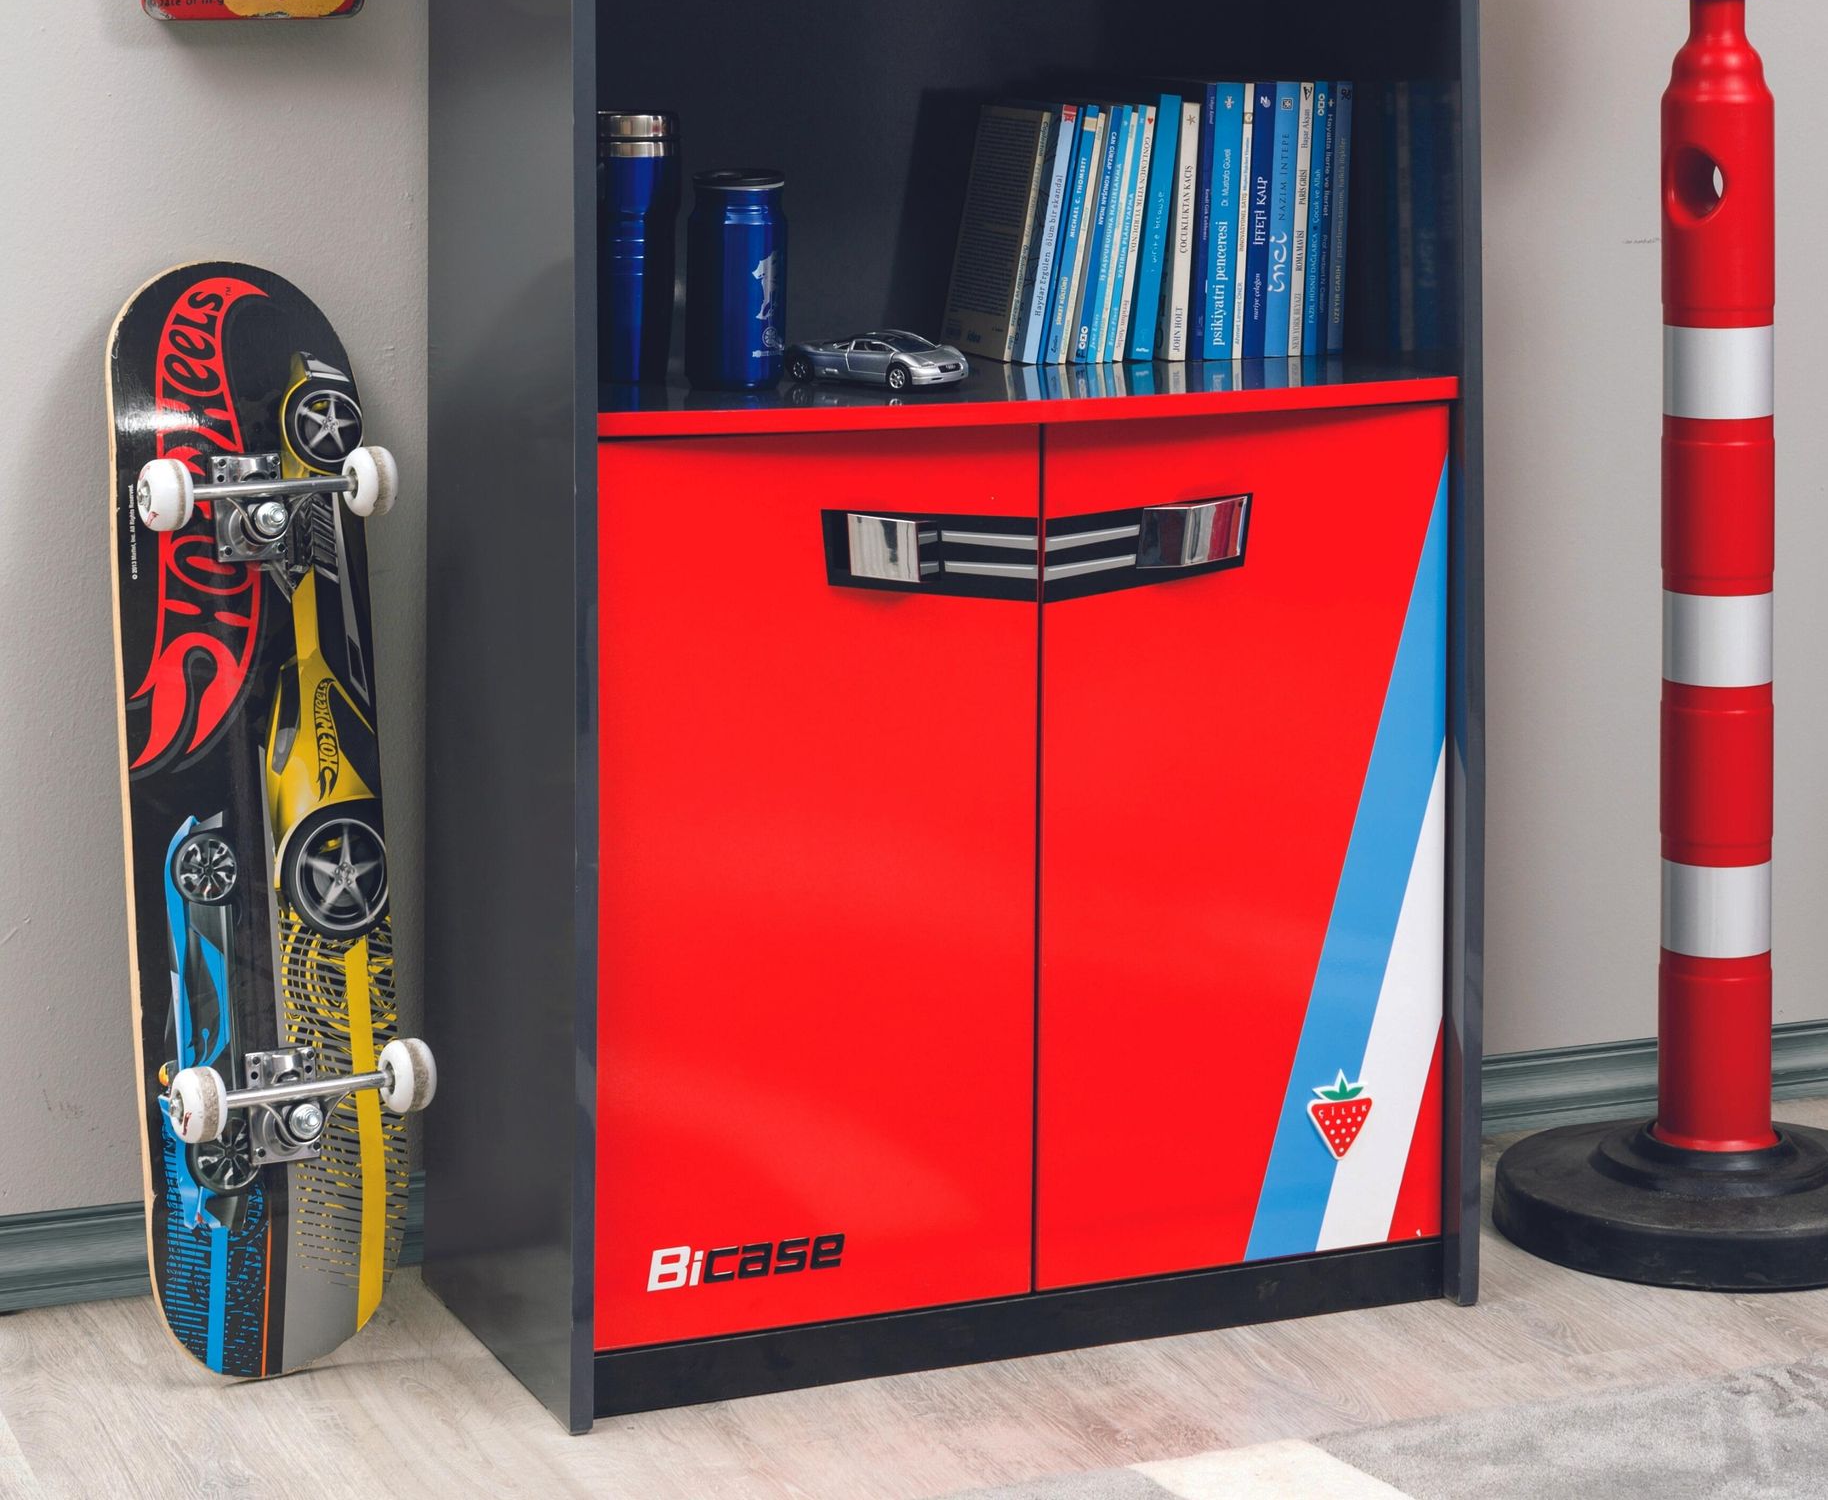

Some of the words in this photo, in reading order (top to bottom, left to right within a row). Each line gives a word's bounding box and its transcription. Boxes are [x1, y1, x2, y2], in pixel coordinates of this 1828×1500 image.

[1109, 131, 1117, 144] CAN
[1324, 113, 1333, 149] Hayatta
[1105, 145, 1115, 170] GÜRZAP
[1221, 169, 1230, 195] Mustafa
[1255, 175, 1267, 204] KALP
[1313, 168, 1321, 187] Allah
[1324, 176, 1330, 187] ve
[1050, 174, 1063, 208] skandal
[1278, 181, 1287, 220] NAZIM
[1048, 210, 1057, 223] bir
[1124, 192, 1134, 219] YAPMA
[1312, 199, 1321, 223] Çocuk
[1068, 205, 1079, 237] MICHAEL
[1178, 191, 1191, 253] ÇOCUKLUKTAN
[1045, 224, 1055, 246] ölüm
[1213, 221, 1230, 280] penceresi
[1294, 252, 1303, 271] ROMA
[1038, 251, 1052, 284] Ergülen
[1034, 286, 1046, 316] Haydar
[1252, 298, 1260, 319] nuriye
[1174, 306, 1183, 328] HOLT
[1210, 284, 1226, 345] psikiyatri
[1172, 329, 1182, 351] JOHN
[646, 1233, 846, 1293] Bicase
